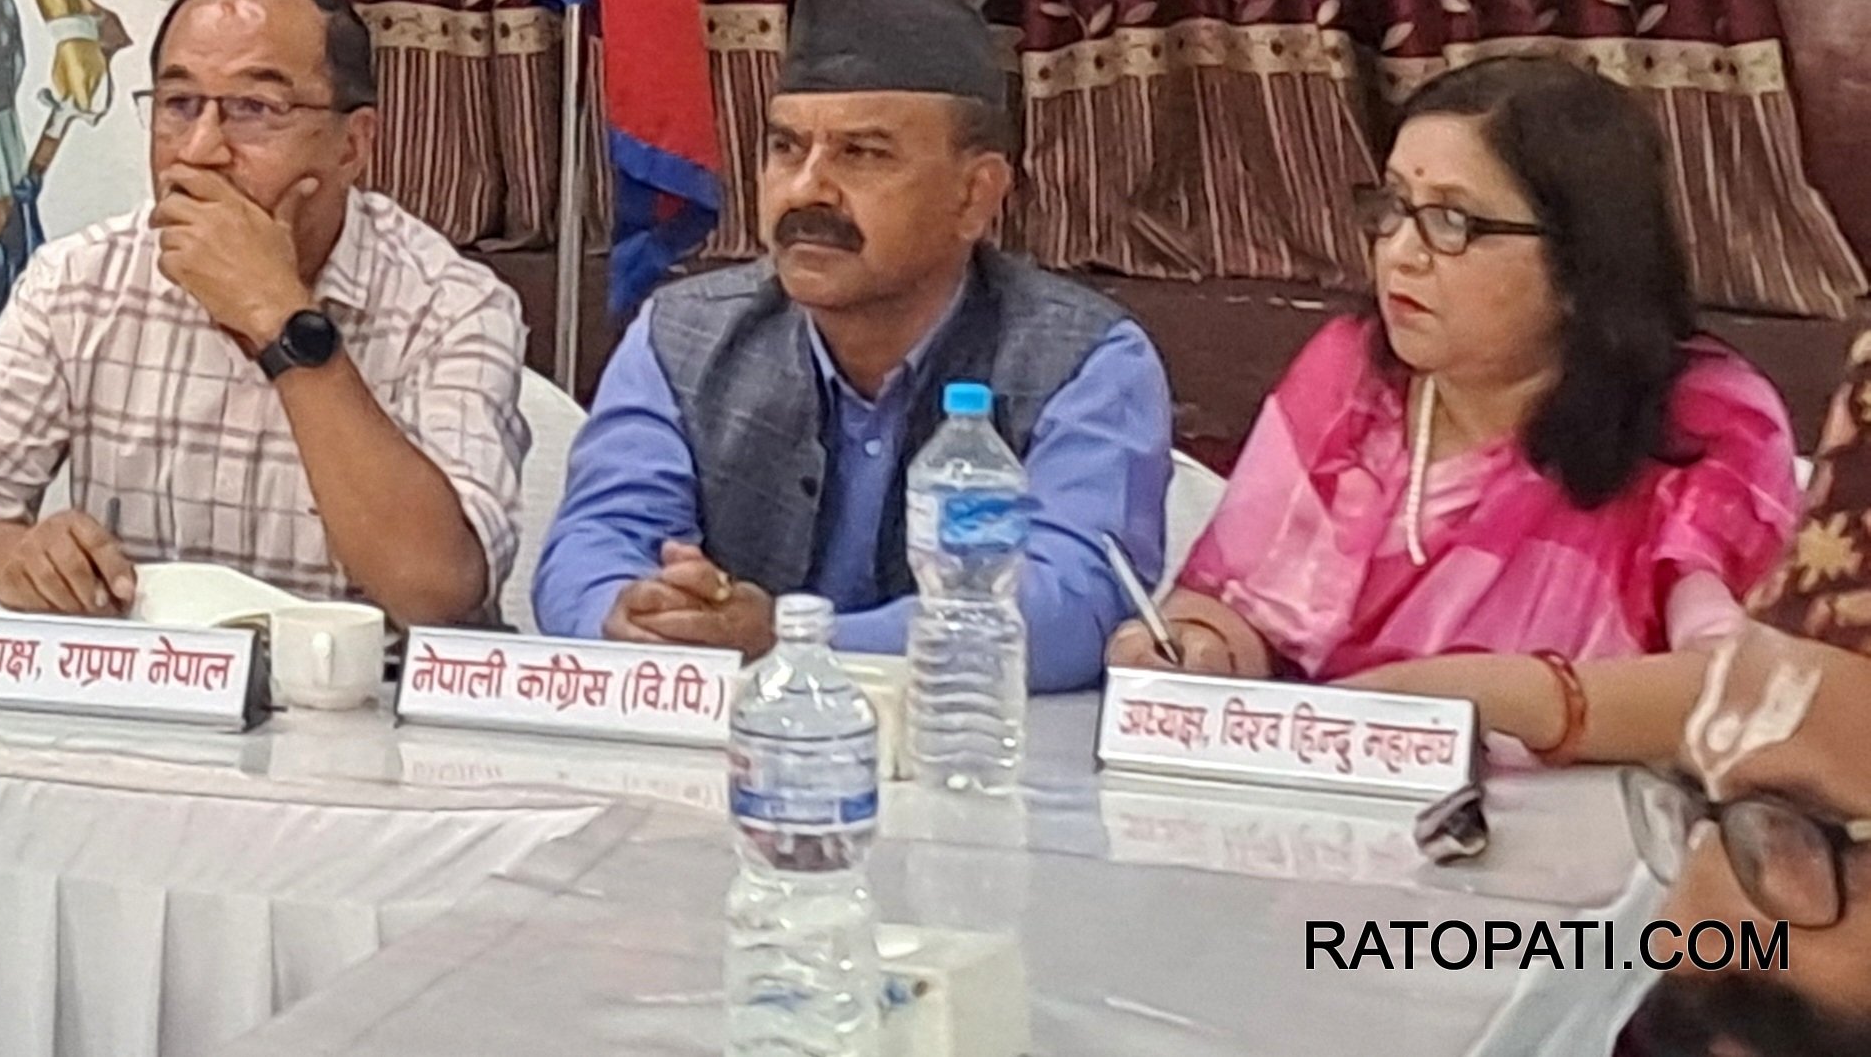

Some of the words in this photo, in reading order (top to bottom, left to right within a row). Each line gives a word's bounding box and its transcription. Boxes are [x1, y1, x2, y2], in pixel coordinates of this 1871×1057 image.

[58, 642, 140, 687] राप्रपा
[147, 635, 235, 691] नेपाल
[412, 642, 507, 699] नेपाली
